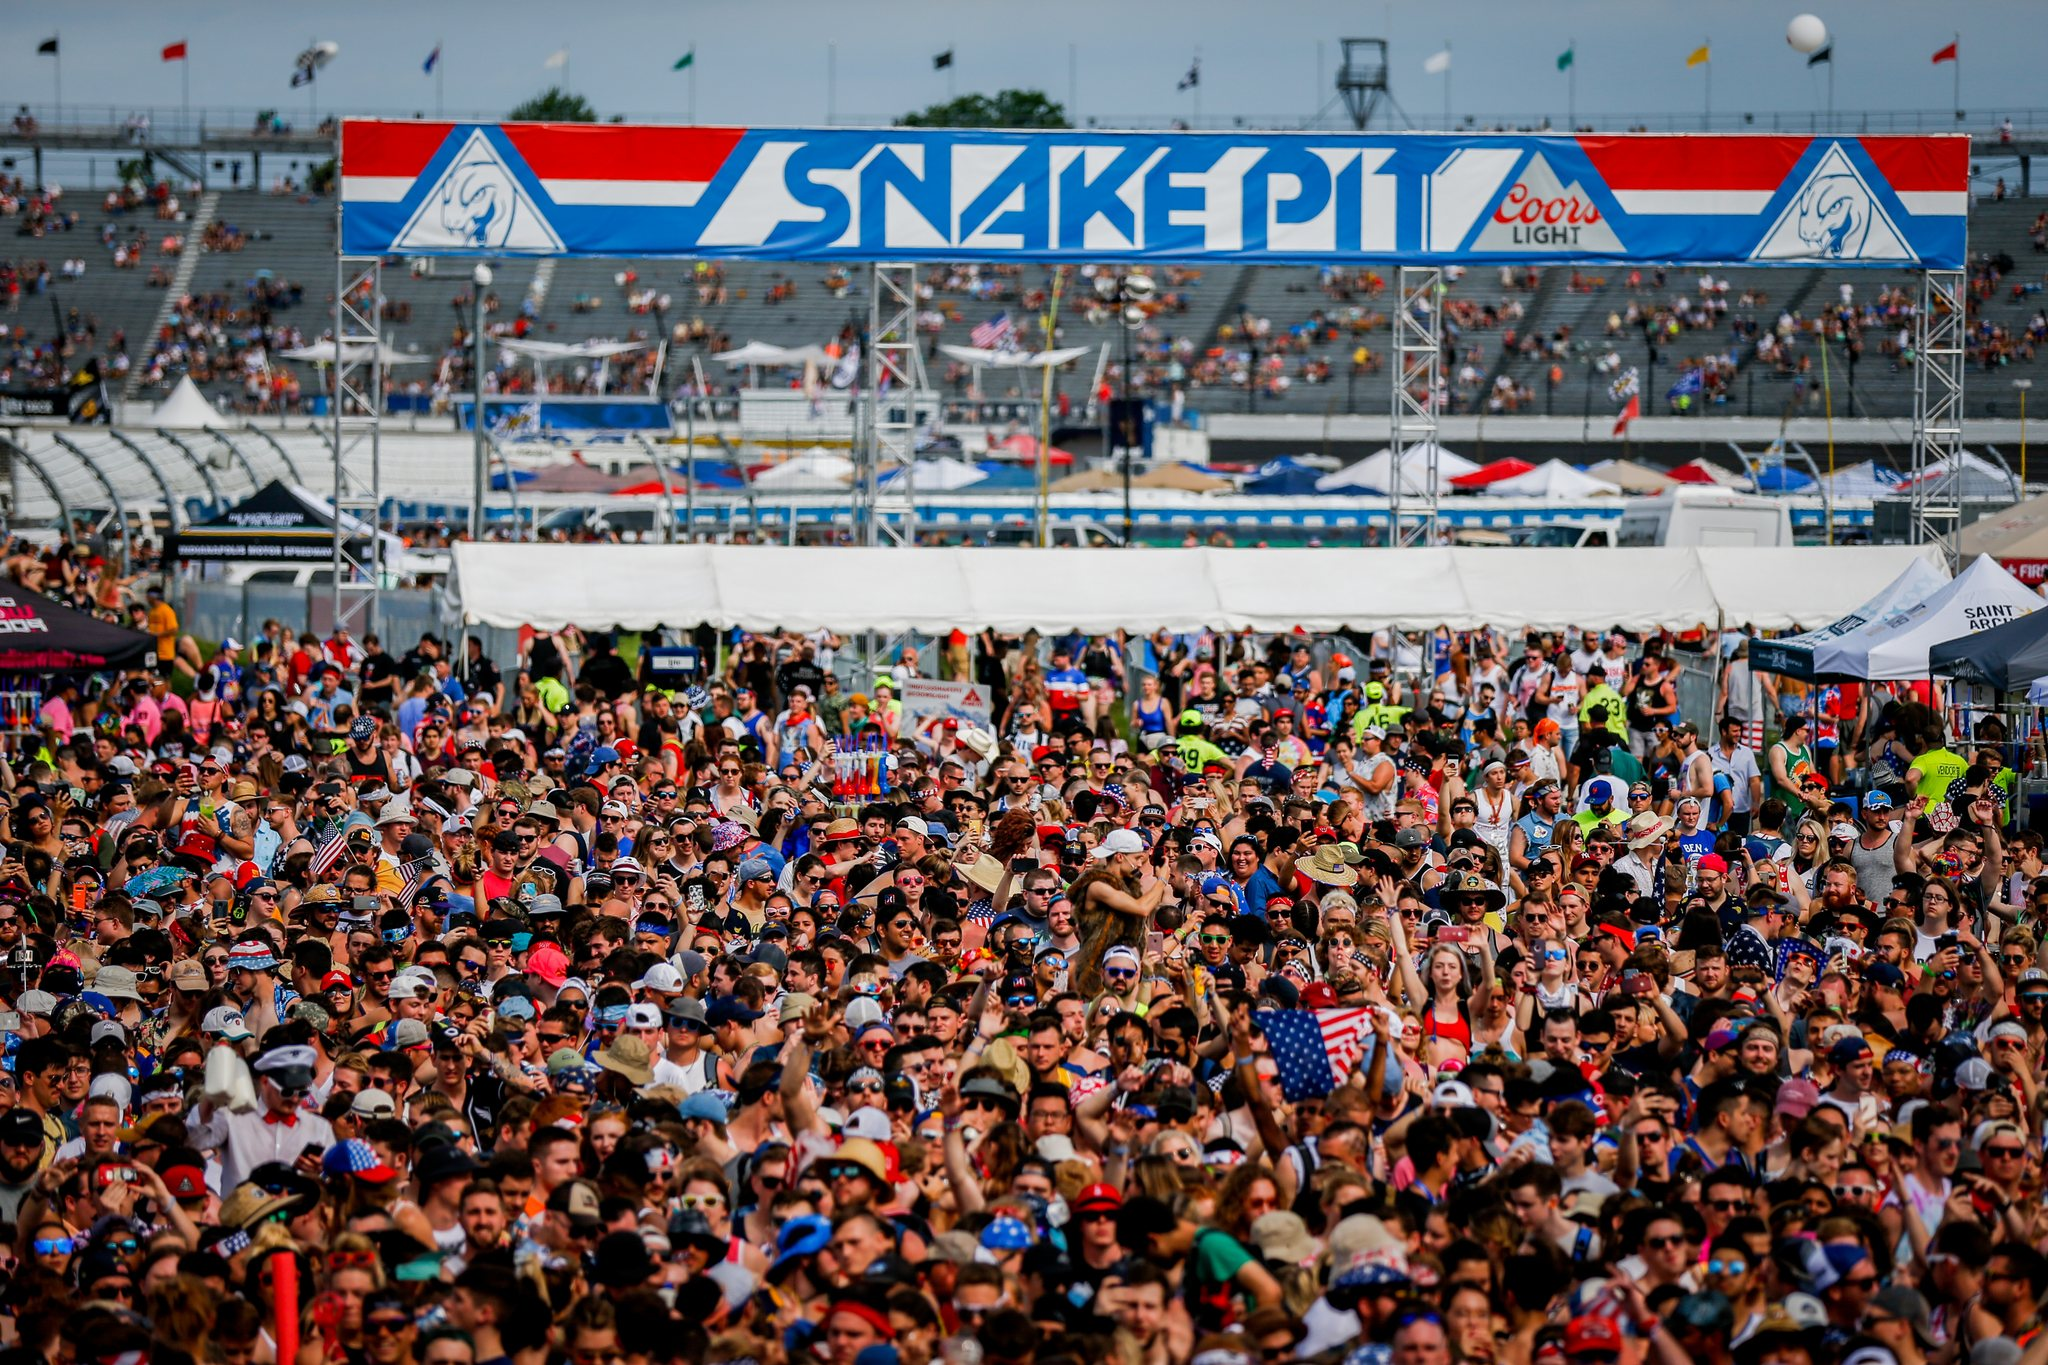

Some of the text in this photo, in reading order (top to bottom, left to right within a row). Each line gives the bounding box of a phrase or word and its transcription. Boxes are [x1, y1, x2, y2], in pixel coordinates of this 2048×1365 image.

[763, 141, 1424, 252] SNAKE PIT
[1493, 183, 1602, 224] Coors
[1513, 226, 1581, 244] LIGHT
[1964, 604, 2013, 619] SAINT
[1937, 765, 1956, 775] VENDOR
[1682, 843, 1702, 853] BEN
